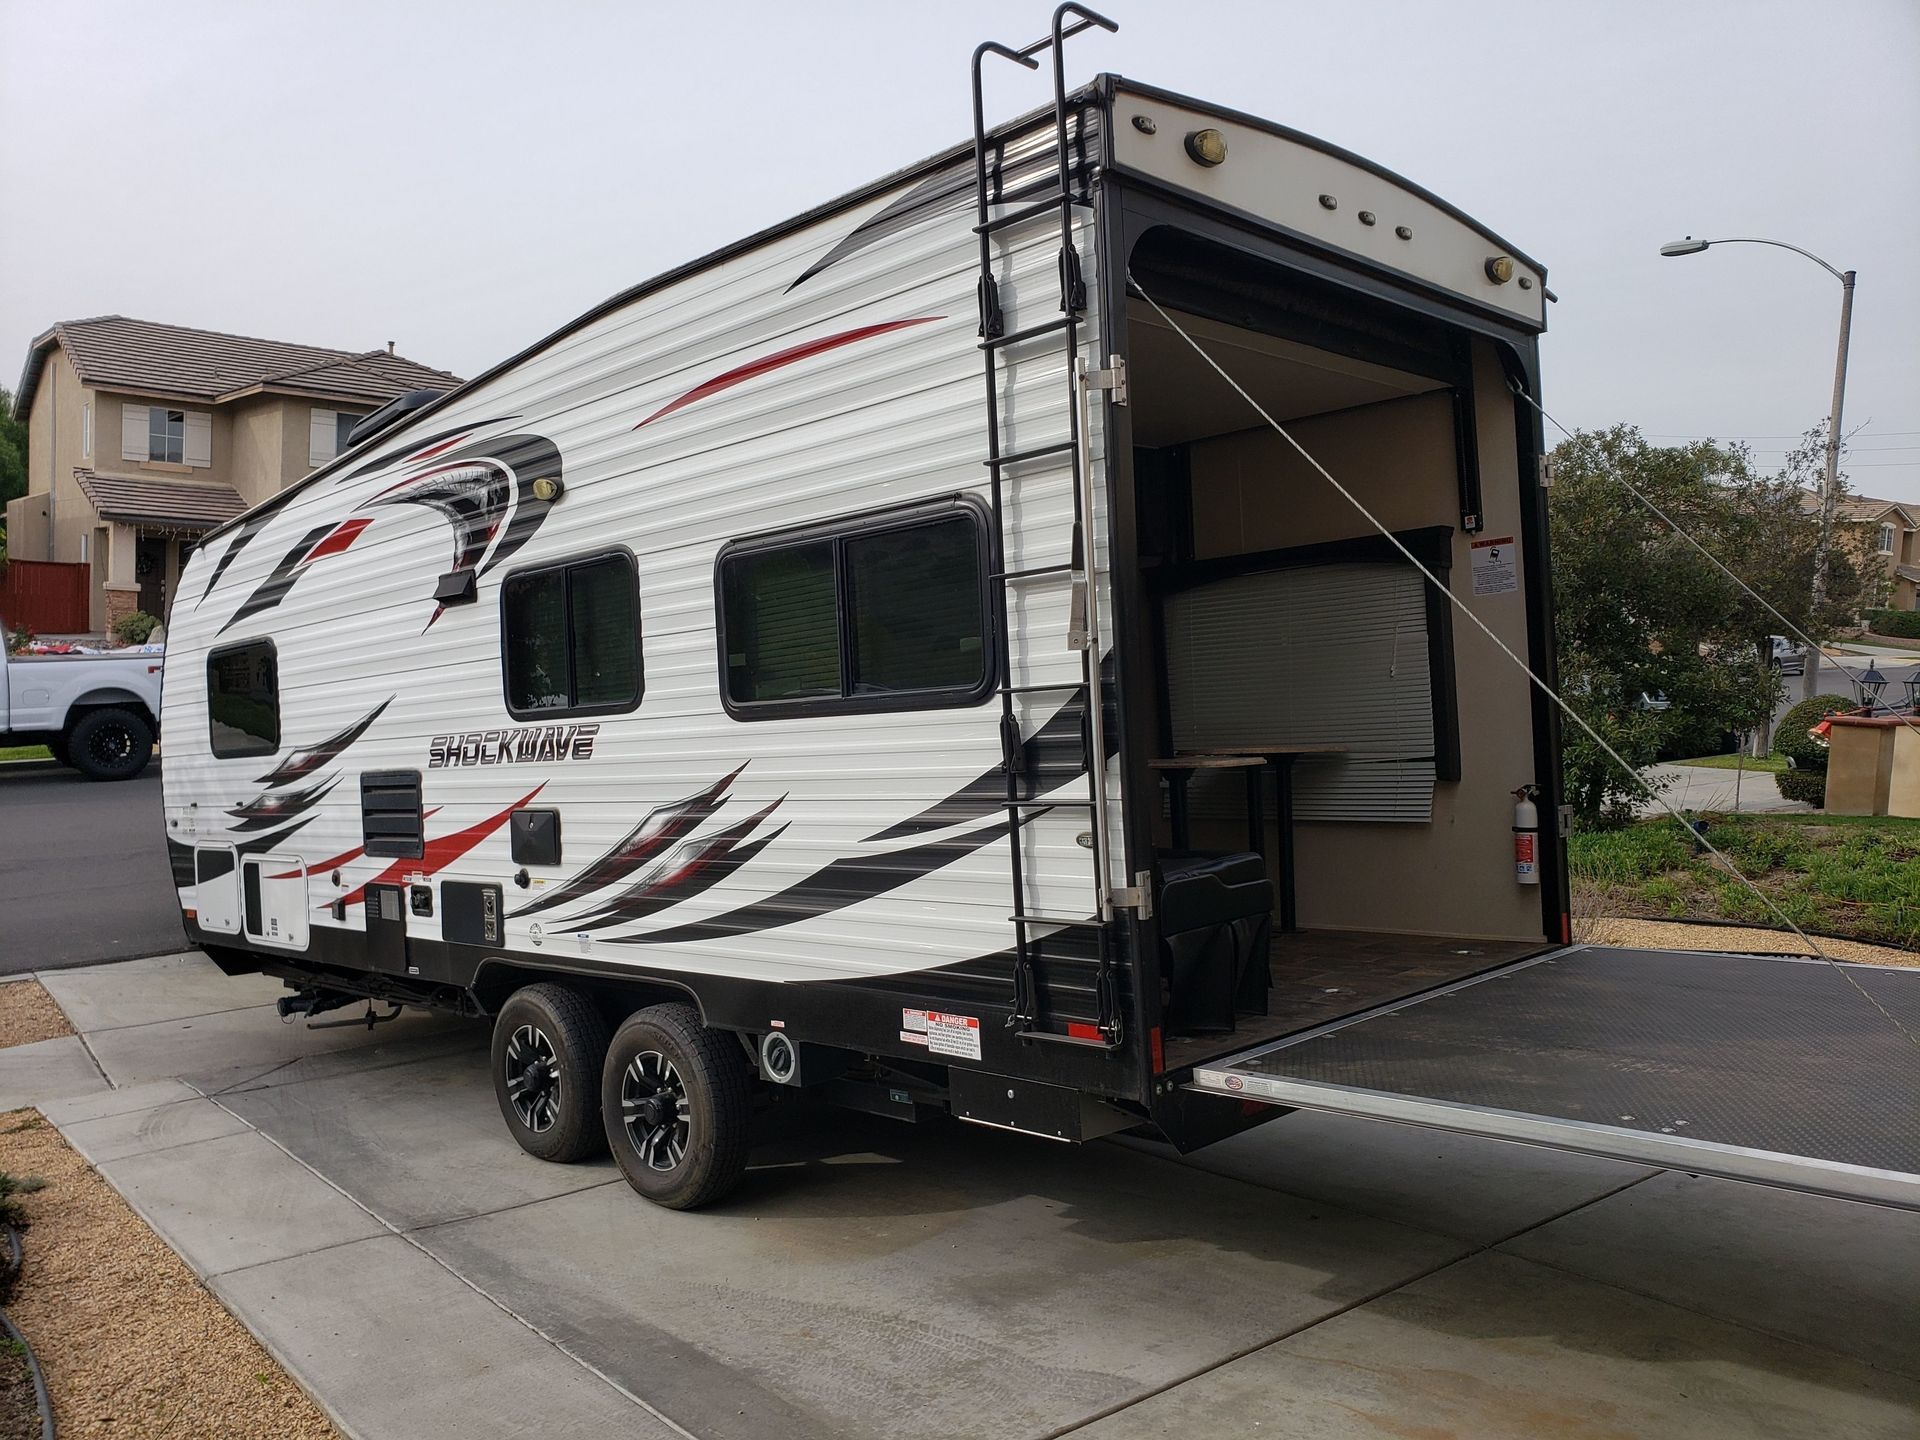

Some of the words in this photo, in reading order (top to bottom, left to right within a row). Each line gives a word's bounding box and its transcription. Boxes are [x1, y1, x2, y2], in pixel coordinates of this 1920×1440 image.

[428, 724, 600, 768] SHOCKWAVE
[941, 1015, 968, 1026] DANGER
[944, 1023, 971, 1031] SMOKING
